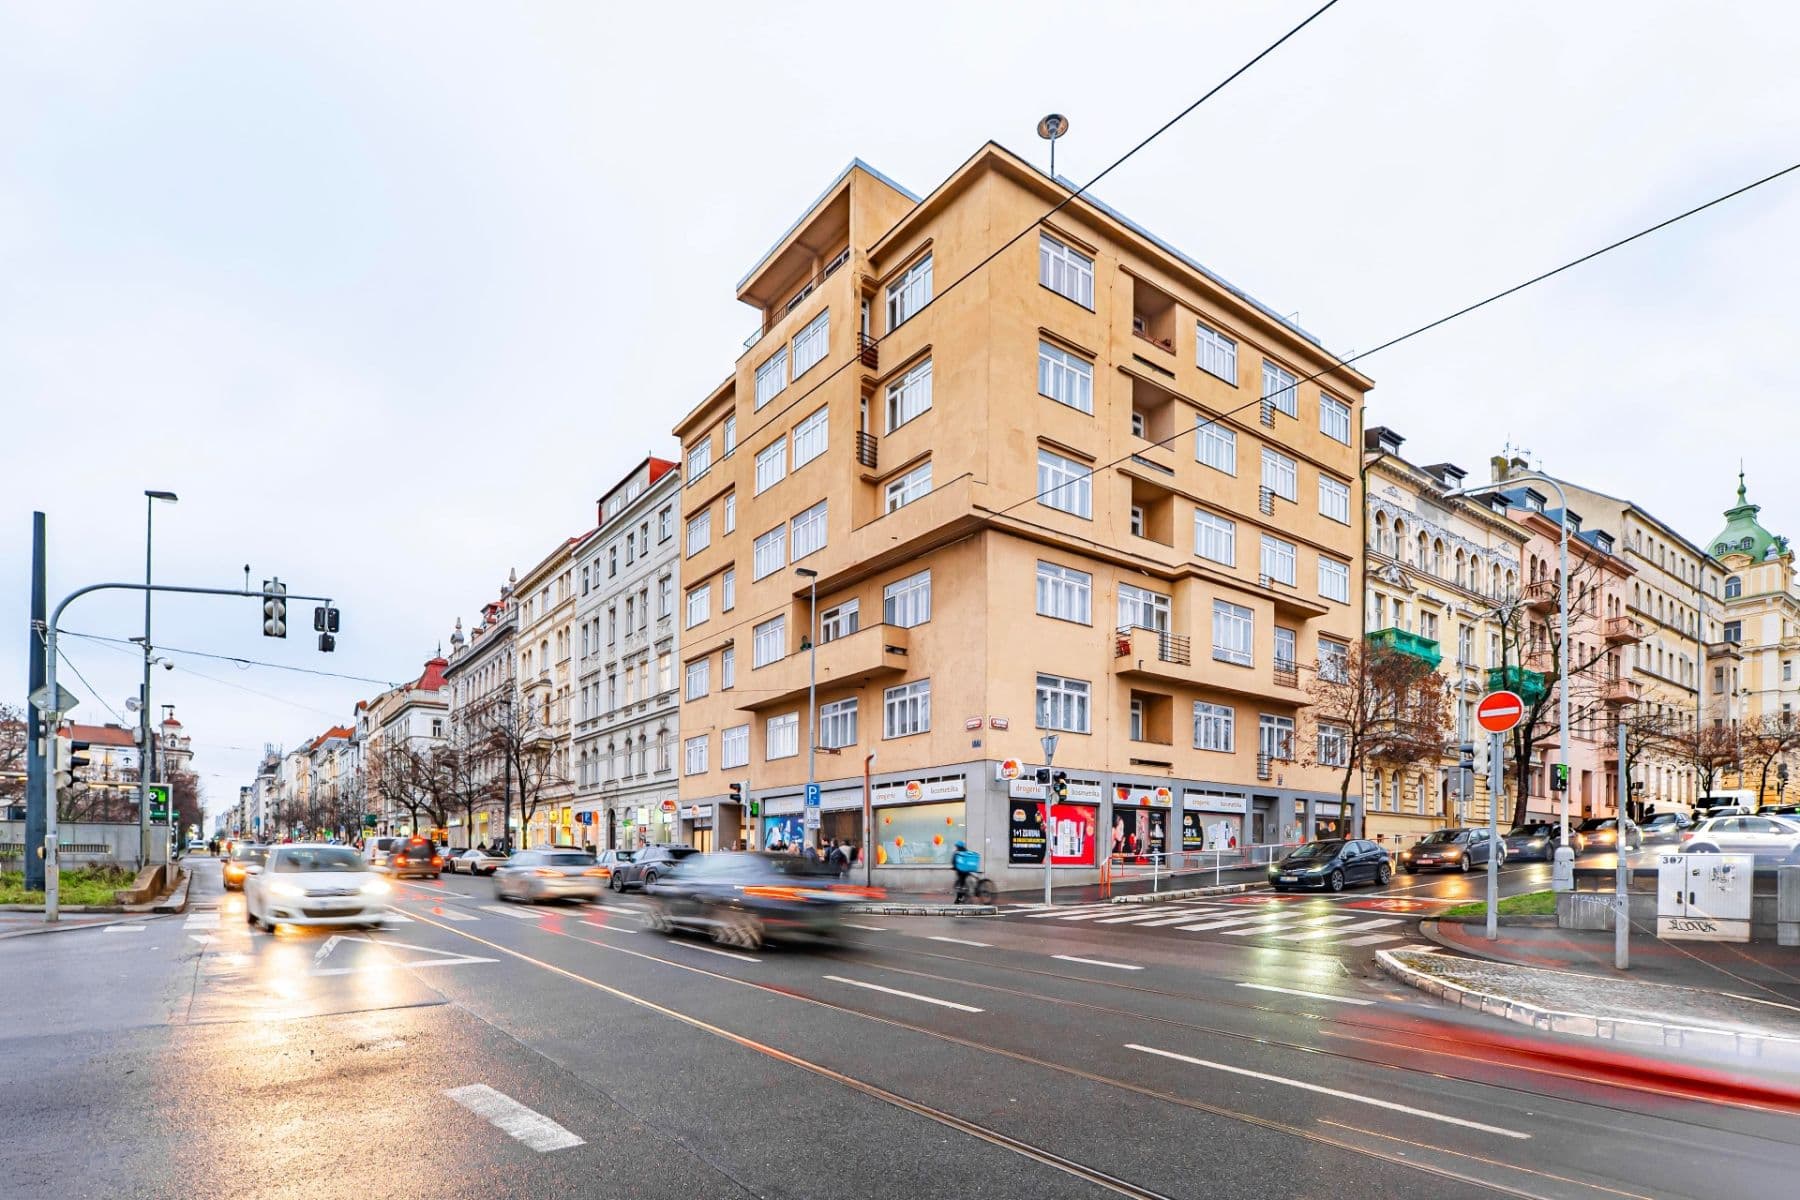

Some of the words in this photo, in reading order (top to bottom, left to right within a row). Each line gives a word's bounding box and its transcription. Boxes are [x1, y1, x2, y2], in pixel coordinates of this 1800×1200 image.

[930, 784, 959, 794] kosmetika
[1015, 783, 1041, 793] drogerie
[808, 786, 818, 803] P
[1013, 829, 1022, 837] 1+1
[1662, 856, 1684, 865] 307
